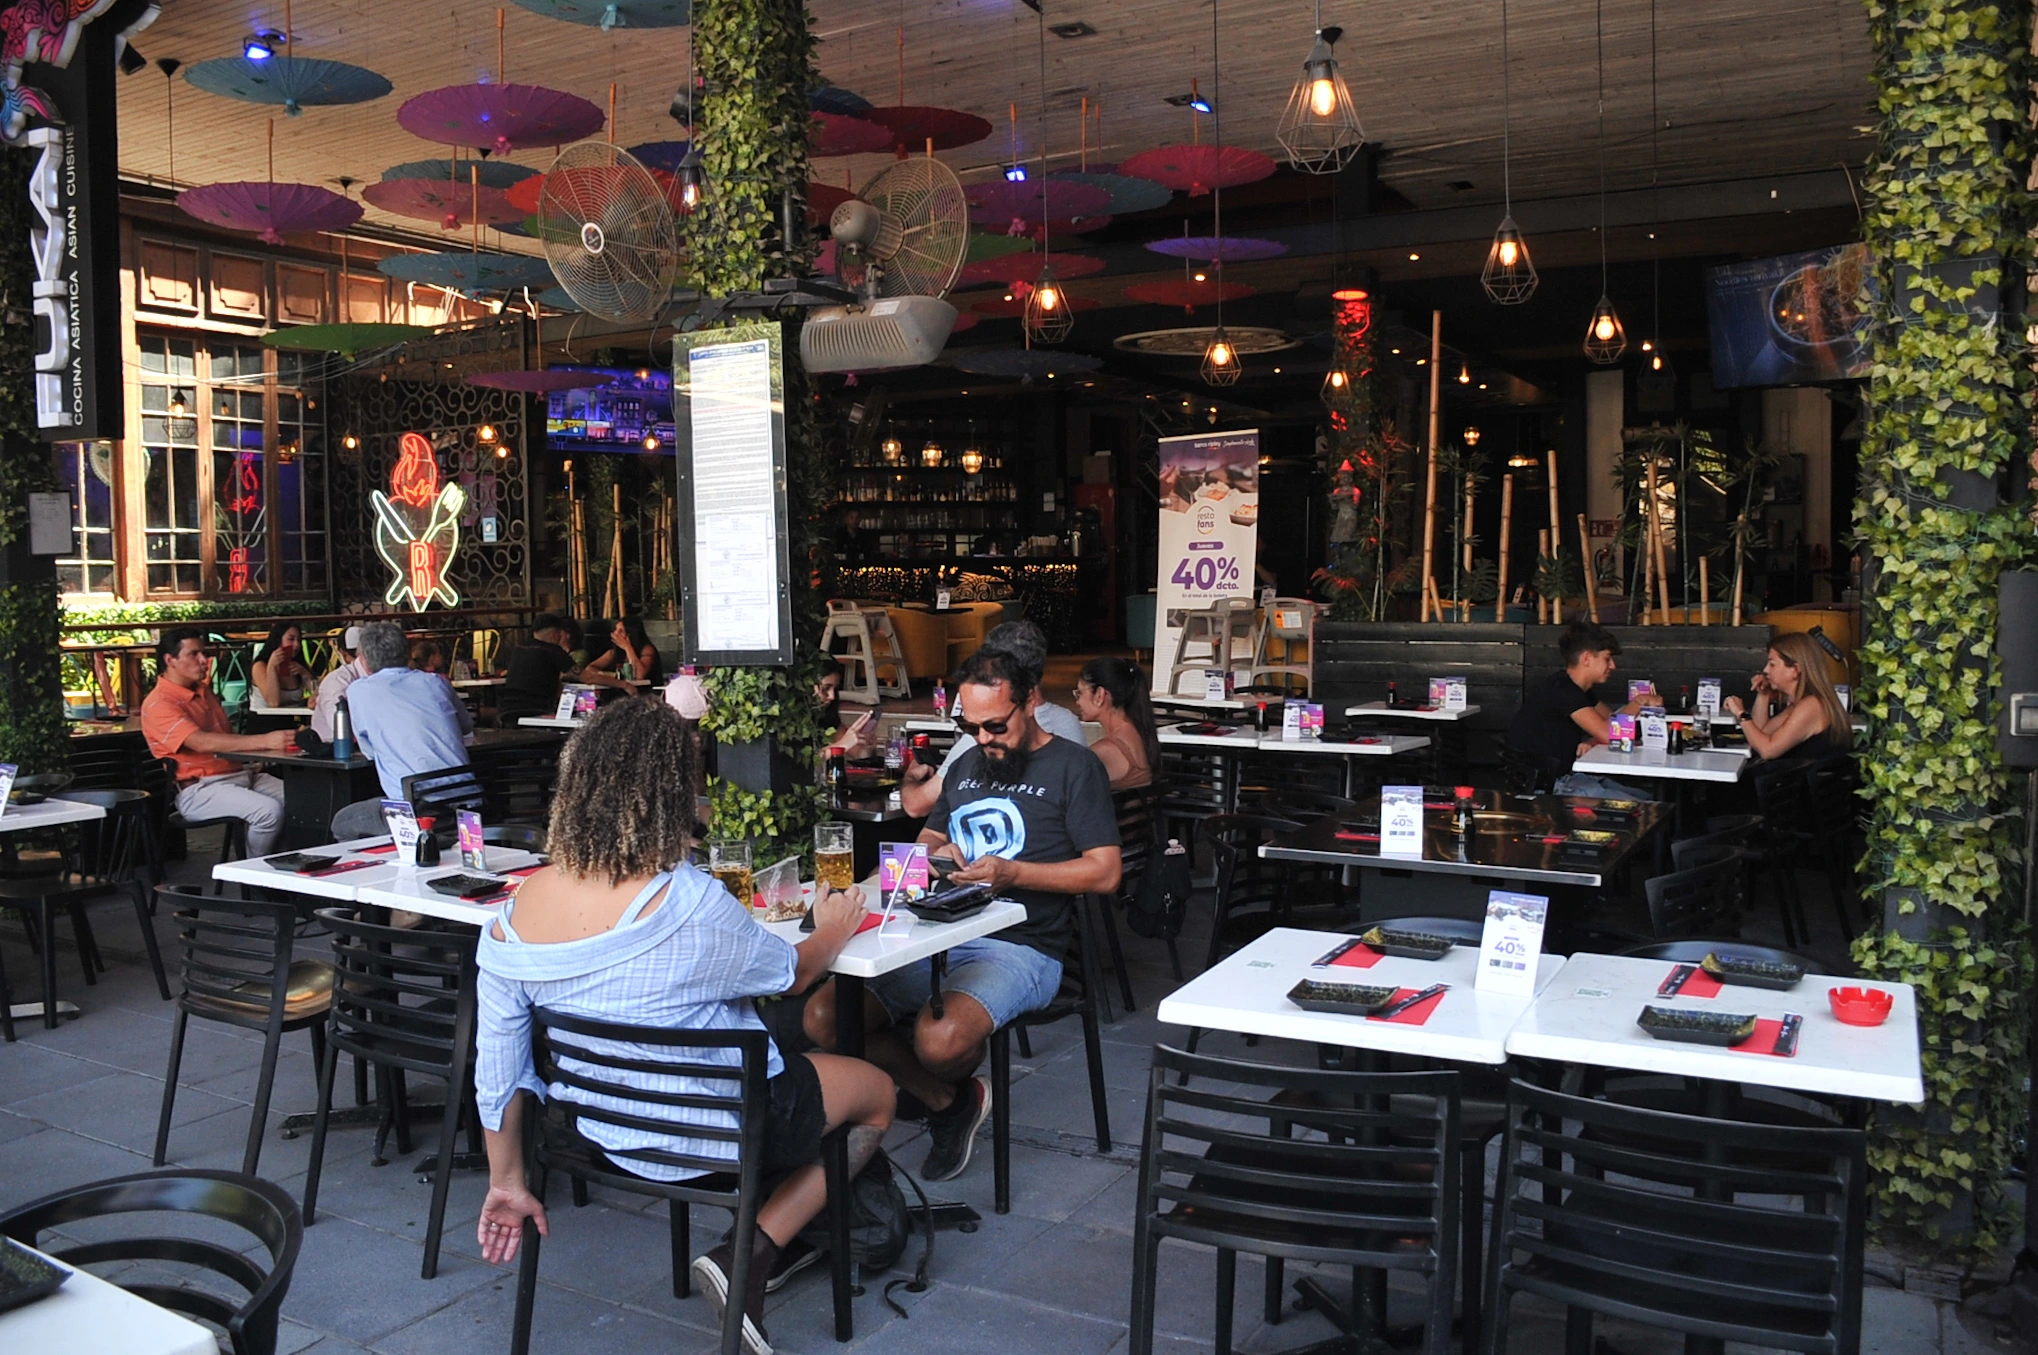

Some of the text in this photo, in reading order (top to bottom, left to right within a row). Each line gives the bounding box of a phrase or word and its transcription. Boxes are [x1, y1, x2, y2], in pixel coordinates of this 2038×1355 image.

[28, 127, 73, 428] FUKAI
[65, 124, 83, 426] COCINA ASIATICA ASIAN CUISINE
[1197, 520, 1215, 529] fans
[1171, 556, 1240, 591] 40%
[1216, 582, 1240, 590] dcto.
[990, 781, 1046, 797] PURPLE
[1391, 818, 1414, 827] 40%
[1494, 940, 1527, 955] 40%
